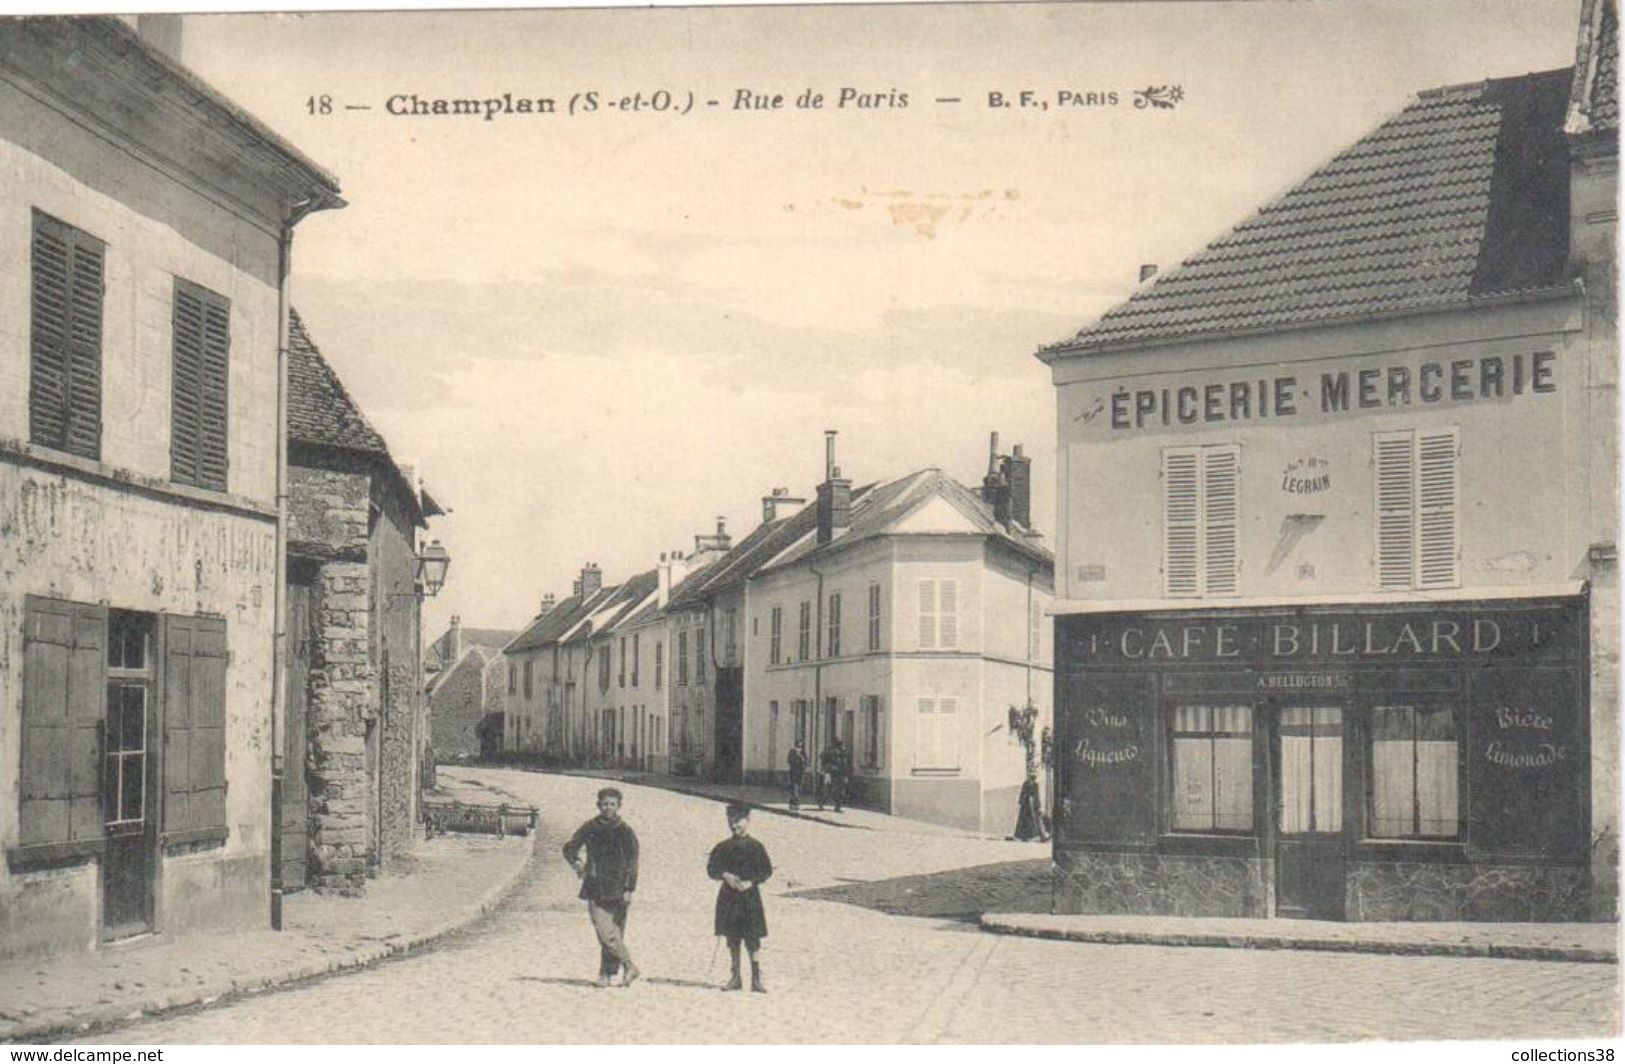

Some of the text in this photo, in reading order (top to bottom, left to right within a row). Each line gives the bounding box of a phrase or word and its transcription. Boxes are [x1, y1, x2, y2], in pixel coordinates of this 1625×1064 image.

[1111, 351, 1556, 430] ÉPICERIE MERCERIE
[1272, 619, 1500, 656] BILLARD
